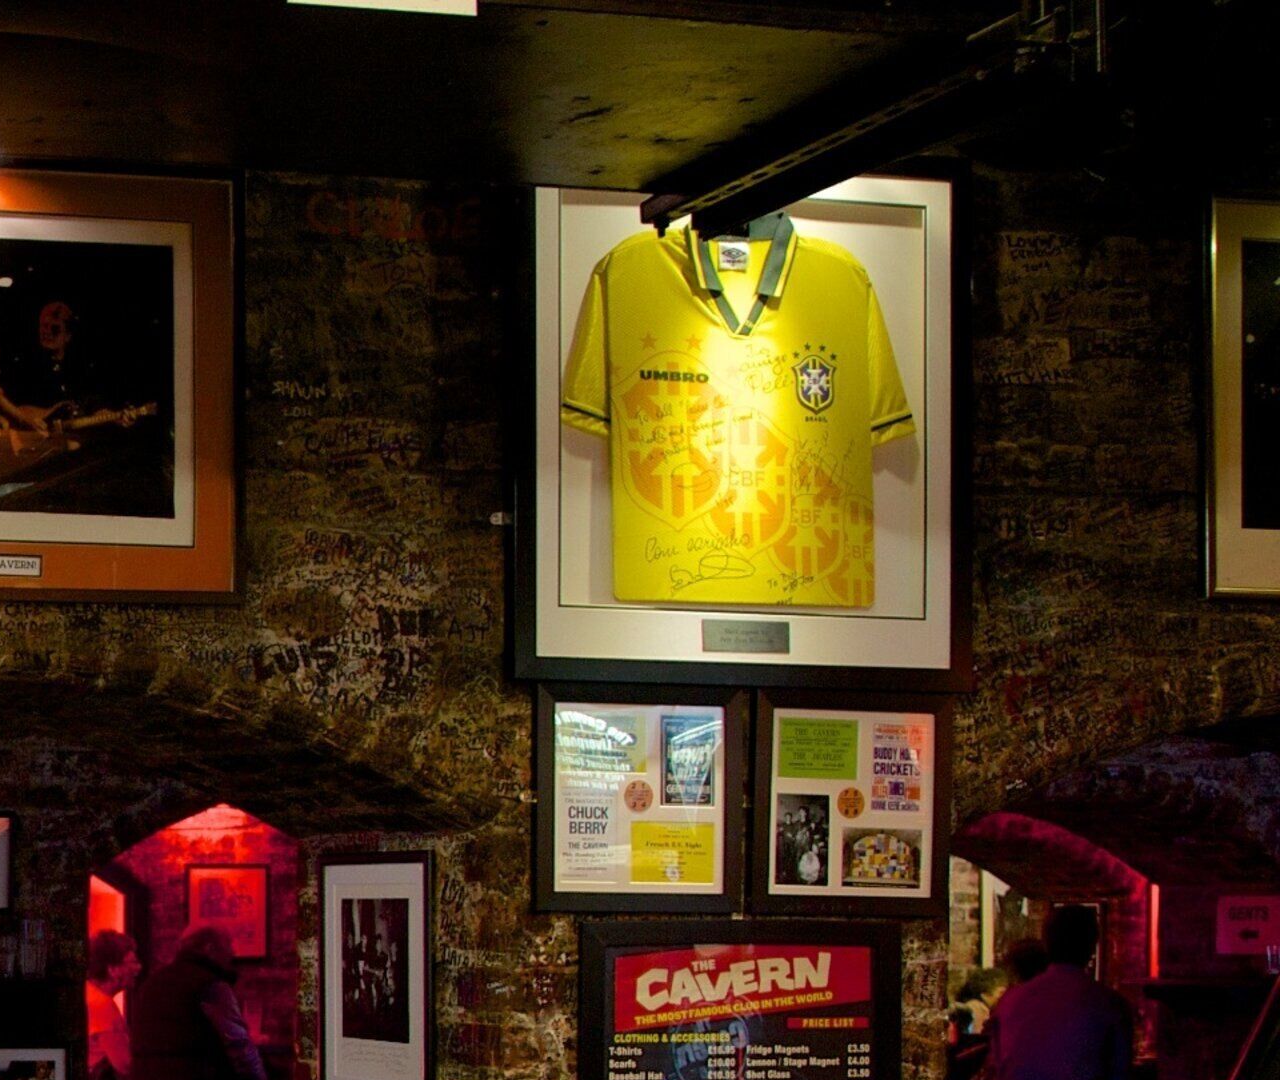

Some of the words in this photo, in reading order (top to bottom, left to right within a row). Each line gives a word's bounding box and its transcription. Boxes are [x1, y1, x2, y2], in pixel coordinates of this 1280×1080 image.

[640, 369, 709, 384] UMBRO
[873, 747, 898, 760] BUDDY
[568, 805, 609, 819] CHUCK
[569, 821, 608, 835] BERRY
[692, 958, 716, 973] THE
[635, 951, 831, 1012] CAVERN
[635, 1014, 657, 1025] THE
[657, 1010, 689, 1022] MOST
[689, 1005, 732, 1018] FAMOUS
[761, 999, 773, 1009] IN
[774, 996, 795, 1007] THE
[795, 991, 833, 1005] WORLD
[802, 1017, 831, 1029] PRICE
[614, 1033, 659, 1043] CLOTHING
[670, 1032, 731, 1043] ACCESSORIES
